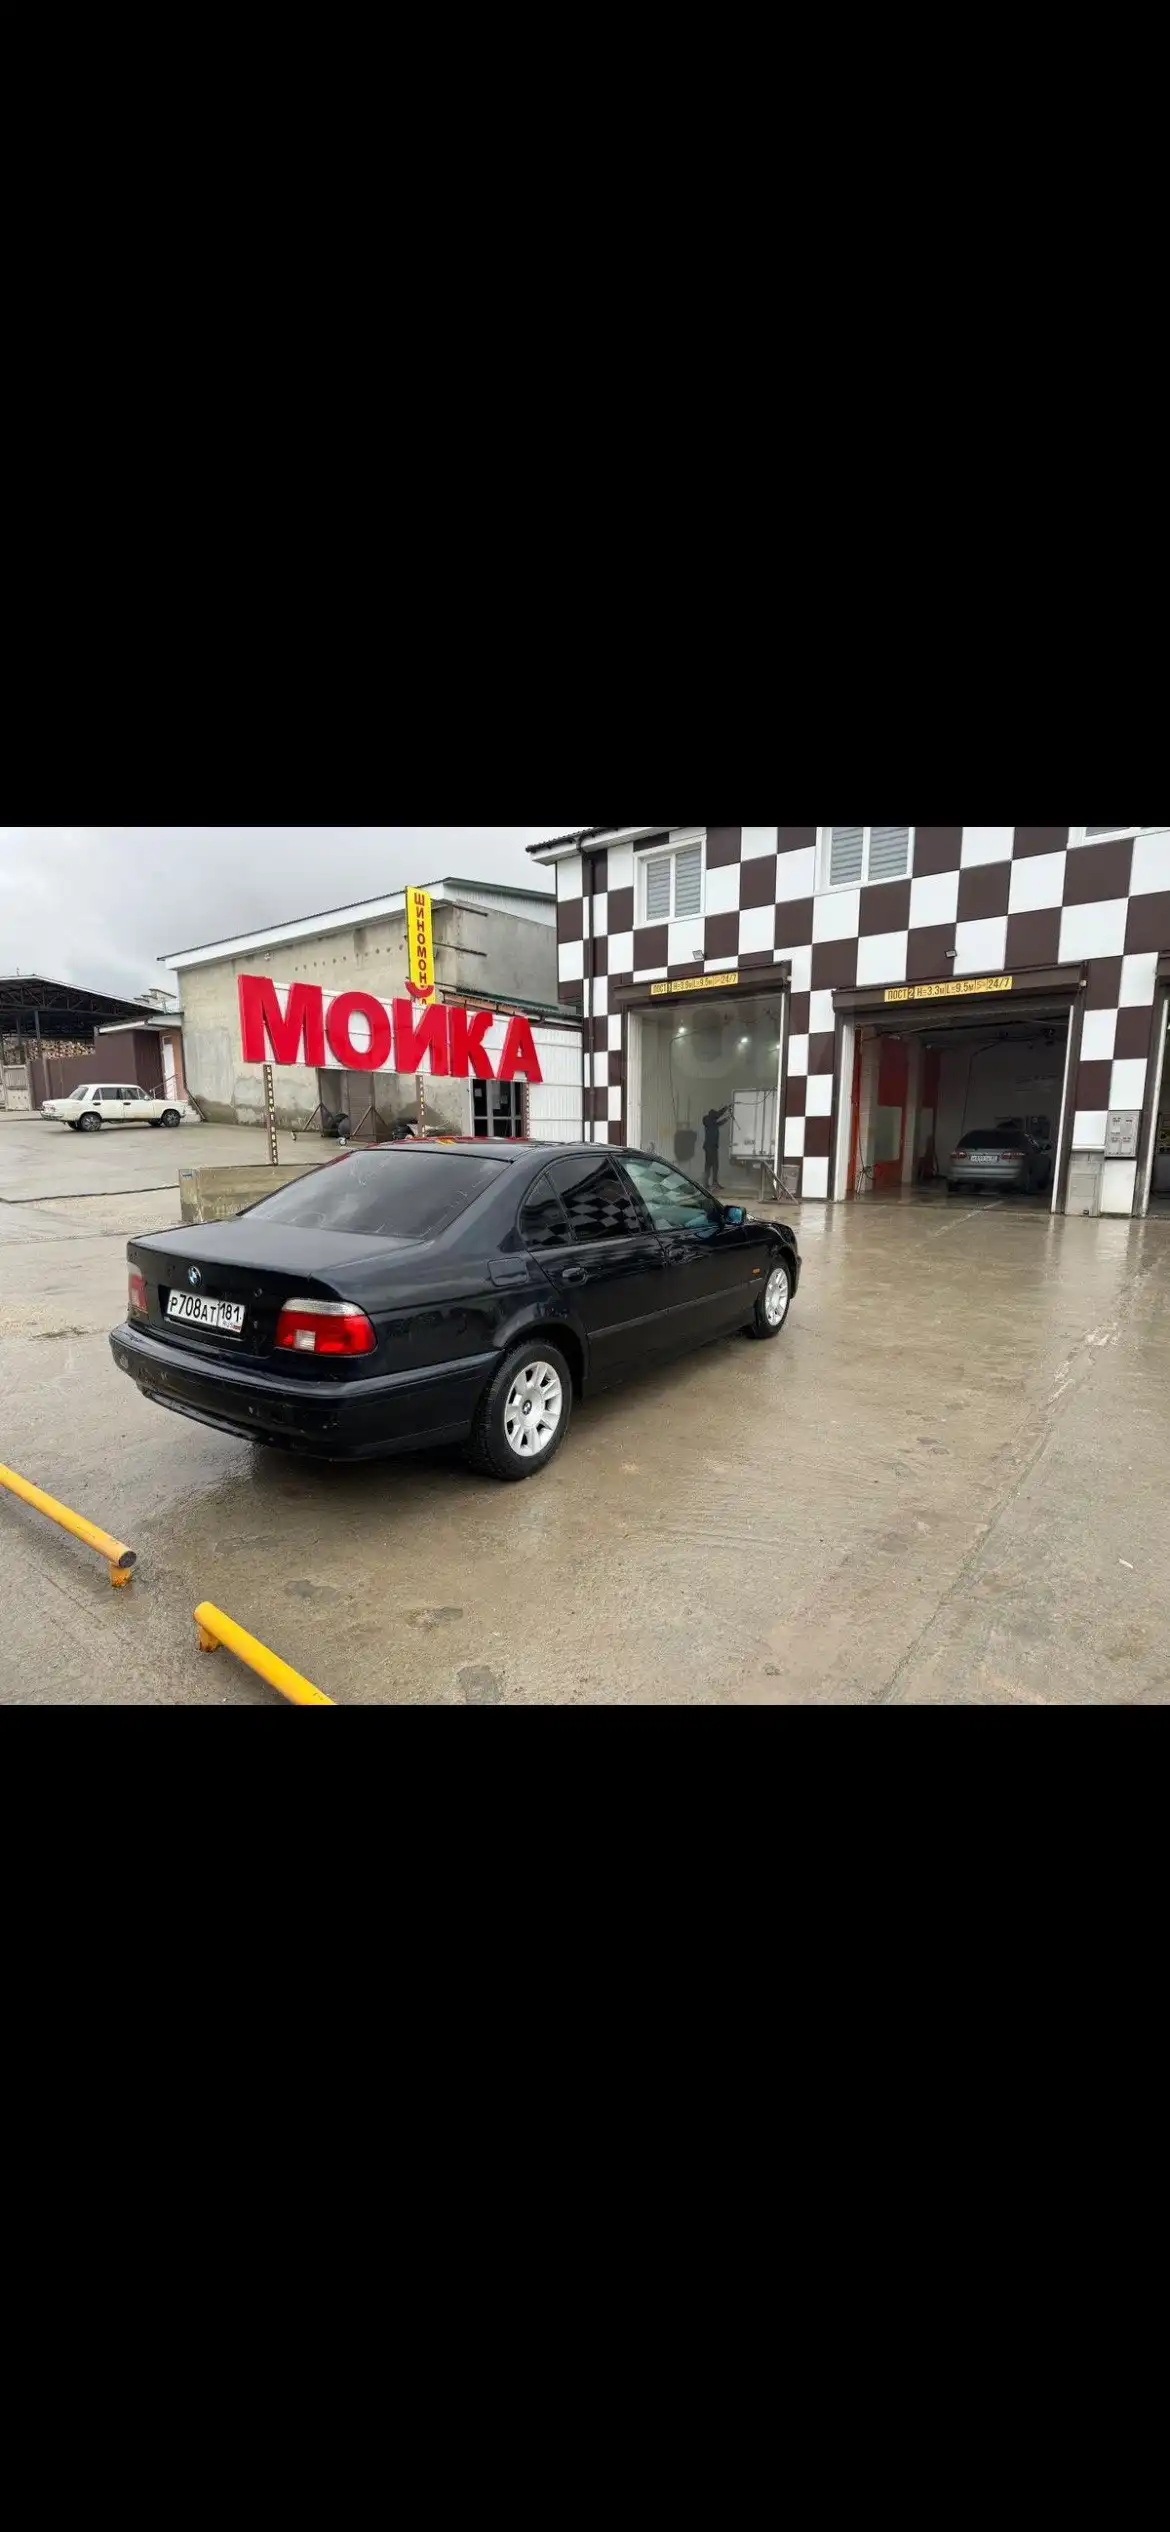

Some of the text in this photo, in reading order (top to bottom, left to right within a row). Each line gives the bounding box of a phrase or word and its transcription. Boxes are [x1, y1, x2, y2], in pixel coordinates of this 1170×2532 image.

[414, 892, 427, 1005] ШИНОМОН
[887, 988, 908, 1000] ПОСТ
[908, 987, 915, 998] 2
[988, 976, 1010, 989] 24/7
[237, 974, 543, 1083] МОЙКА
[170, 1294, 240, 1323] Р708АТ 181
